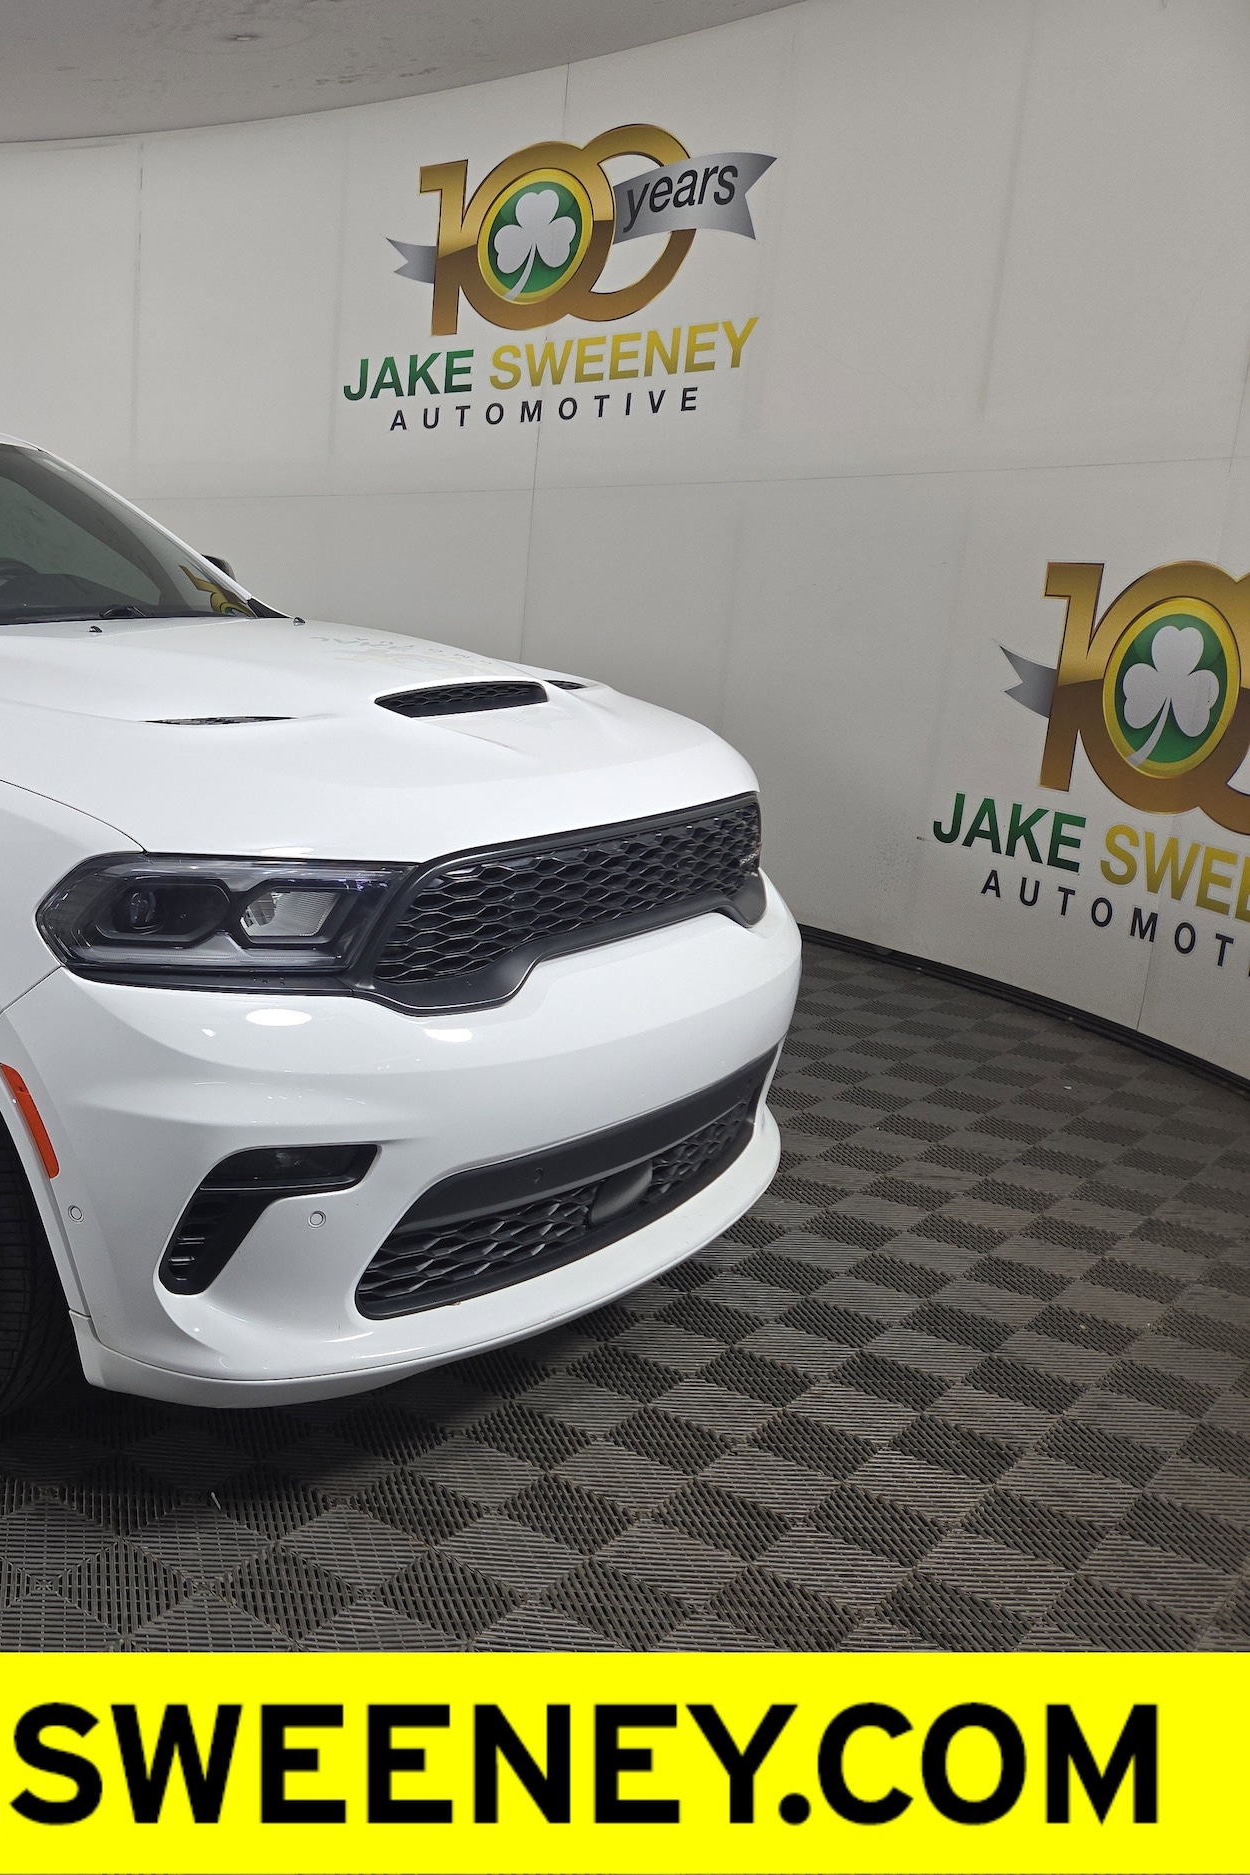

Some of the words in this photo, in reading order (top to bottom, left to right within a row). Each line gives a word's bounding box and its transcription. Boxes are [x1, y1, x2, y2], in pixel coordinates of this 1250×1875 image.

[419, 123, 697, 336] 100
[622, 163, 739, 234] years
[344, 349, 474, 401] JAKE
[490, 317, 759, 390] SWEENEY
[390, 387, 698, 431] AUTOMOTIVE
[933, 792, 1087, 873] JAKE
